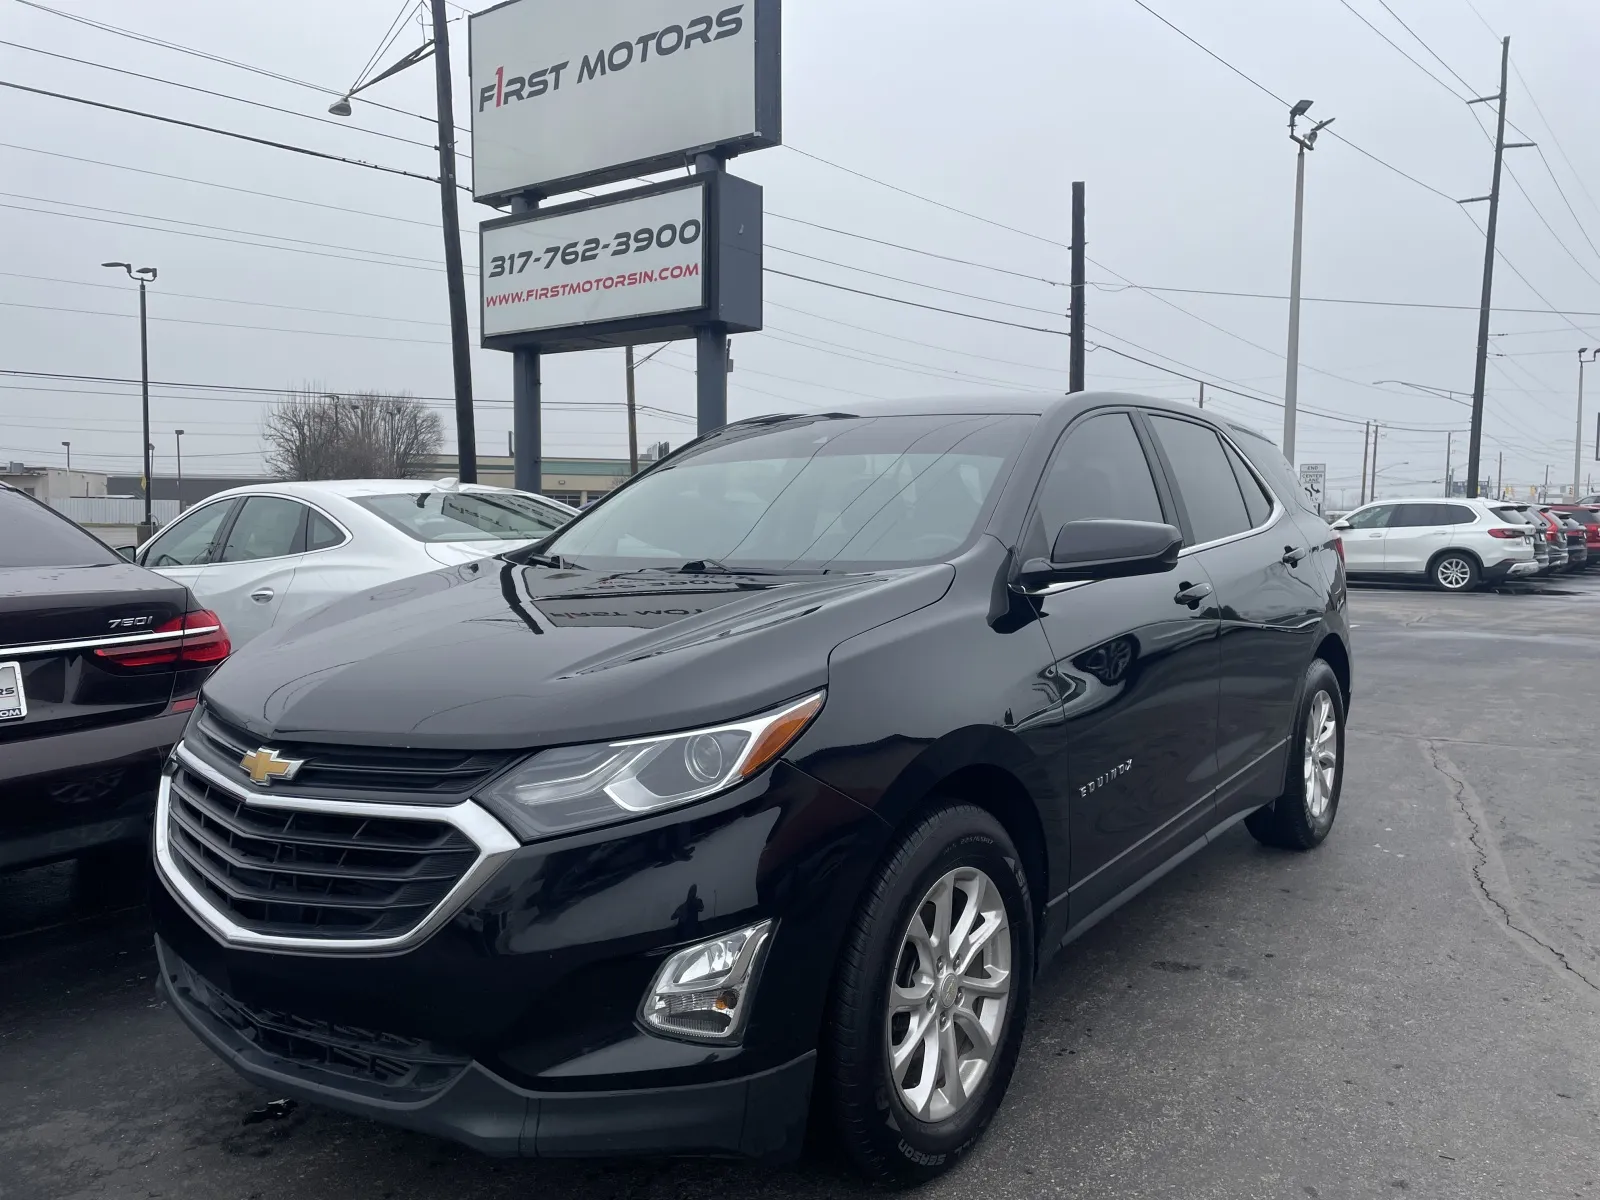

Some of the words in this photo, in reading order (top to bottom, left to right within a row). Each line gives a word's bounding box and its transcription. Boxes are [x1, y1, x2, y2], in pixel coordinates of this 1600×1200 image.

[576, 4, 744, 84] MOTORS
[488, 219, 701, 278] 317-762-3900
[485, 263, 699, 308] WWW.FIRSTMOTORSIN.COM
[1079, 758, 1133, 798] EQUINOX
